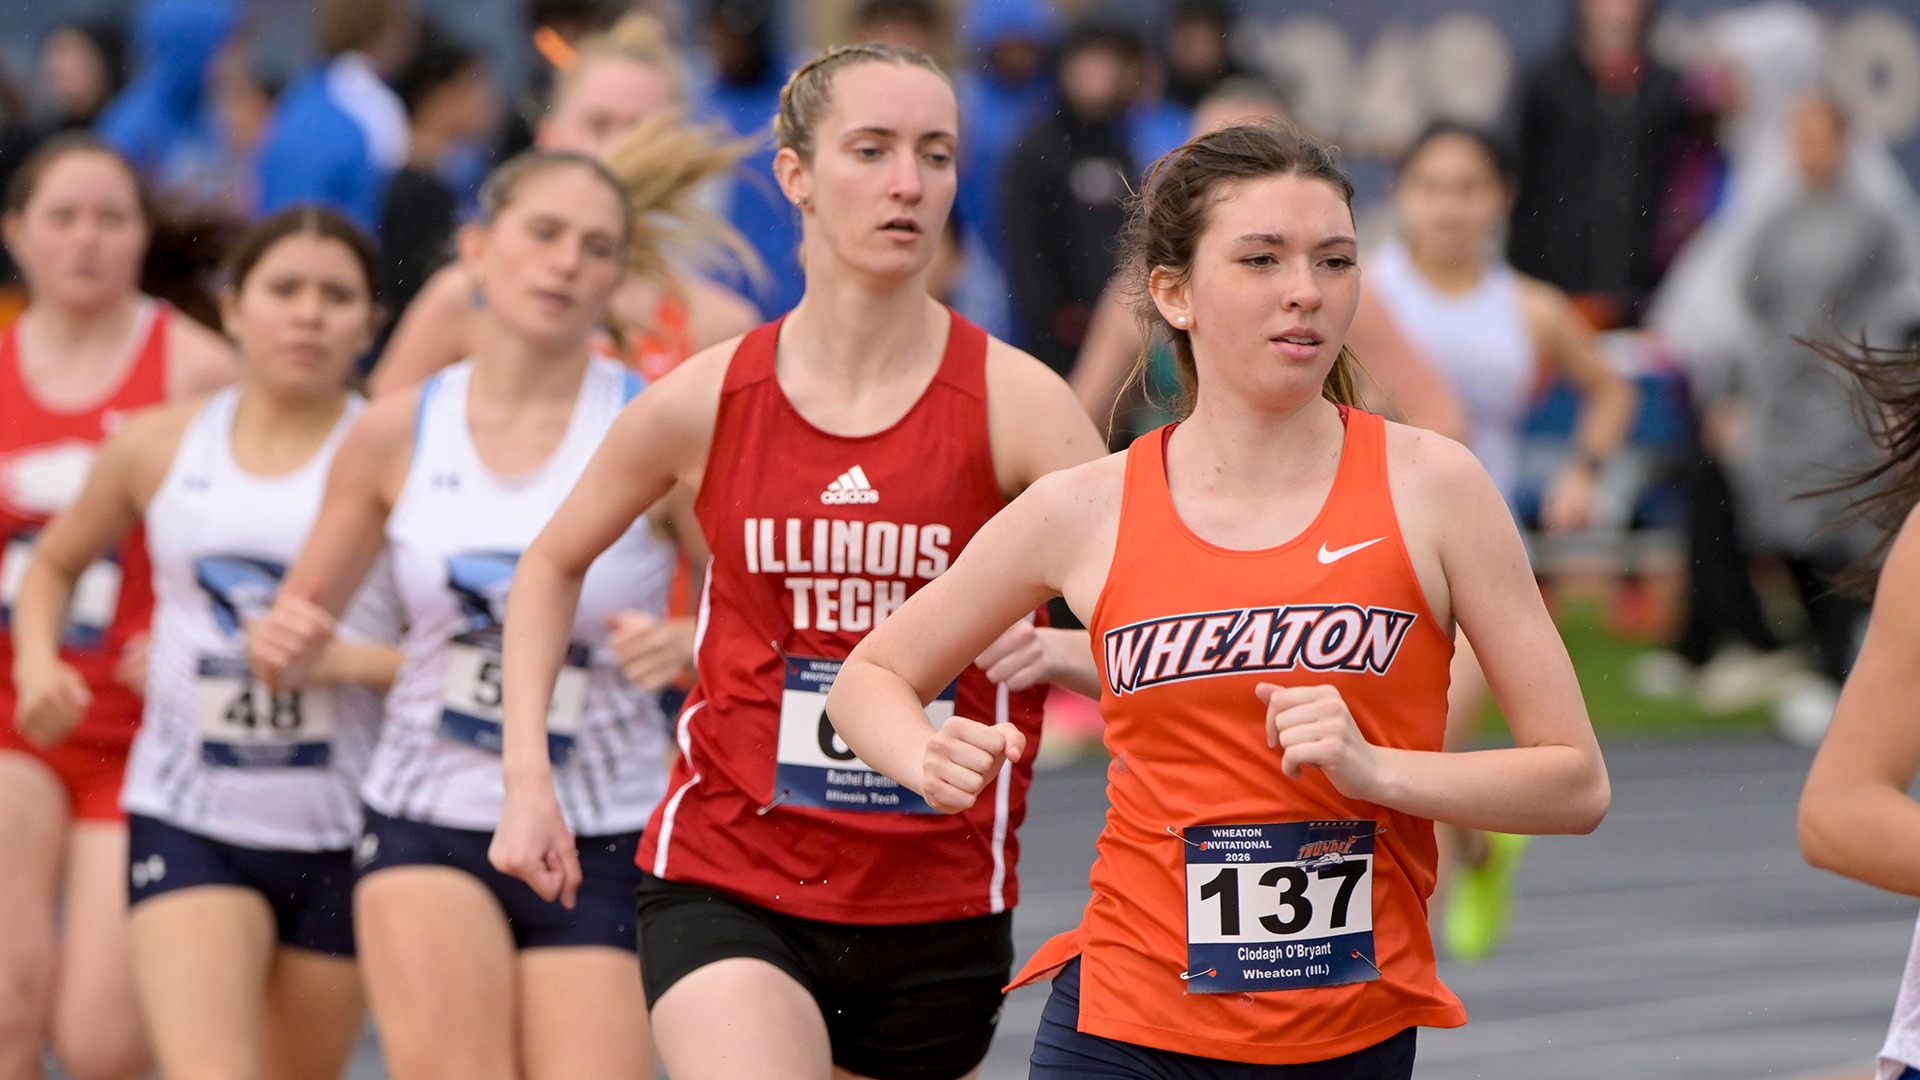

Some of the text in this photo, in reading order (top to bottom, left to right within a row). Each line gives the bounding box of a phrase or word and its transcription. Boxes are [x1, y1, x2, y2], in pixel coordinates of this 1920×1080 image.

[820, 490, 880, 505] adidas
[744, 518, 951, 579] ILLINOIS
[784, 577, 907, 632] TECH
[1104, 603, 1419, 697] WHEATON
[827, 769, 863, 785] Rachel
[826, 789, 900, 805] Illinois Tech
[1212, 828, 1262, 838] WHEATON
[1204, 840, 1272, 850] NVITATIONAL
[1225, 853, 1251, 862] 2026
[1200, 859, 1368, 936] 137
[1237, 942, 1332, 963] Clodagh O'Bryant
[1243, 964, 1330, 980] Wheaton (Ill.)
